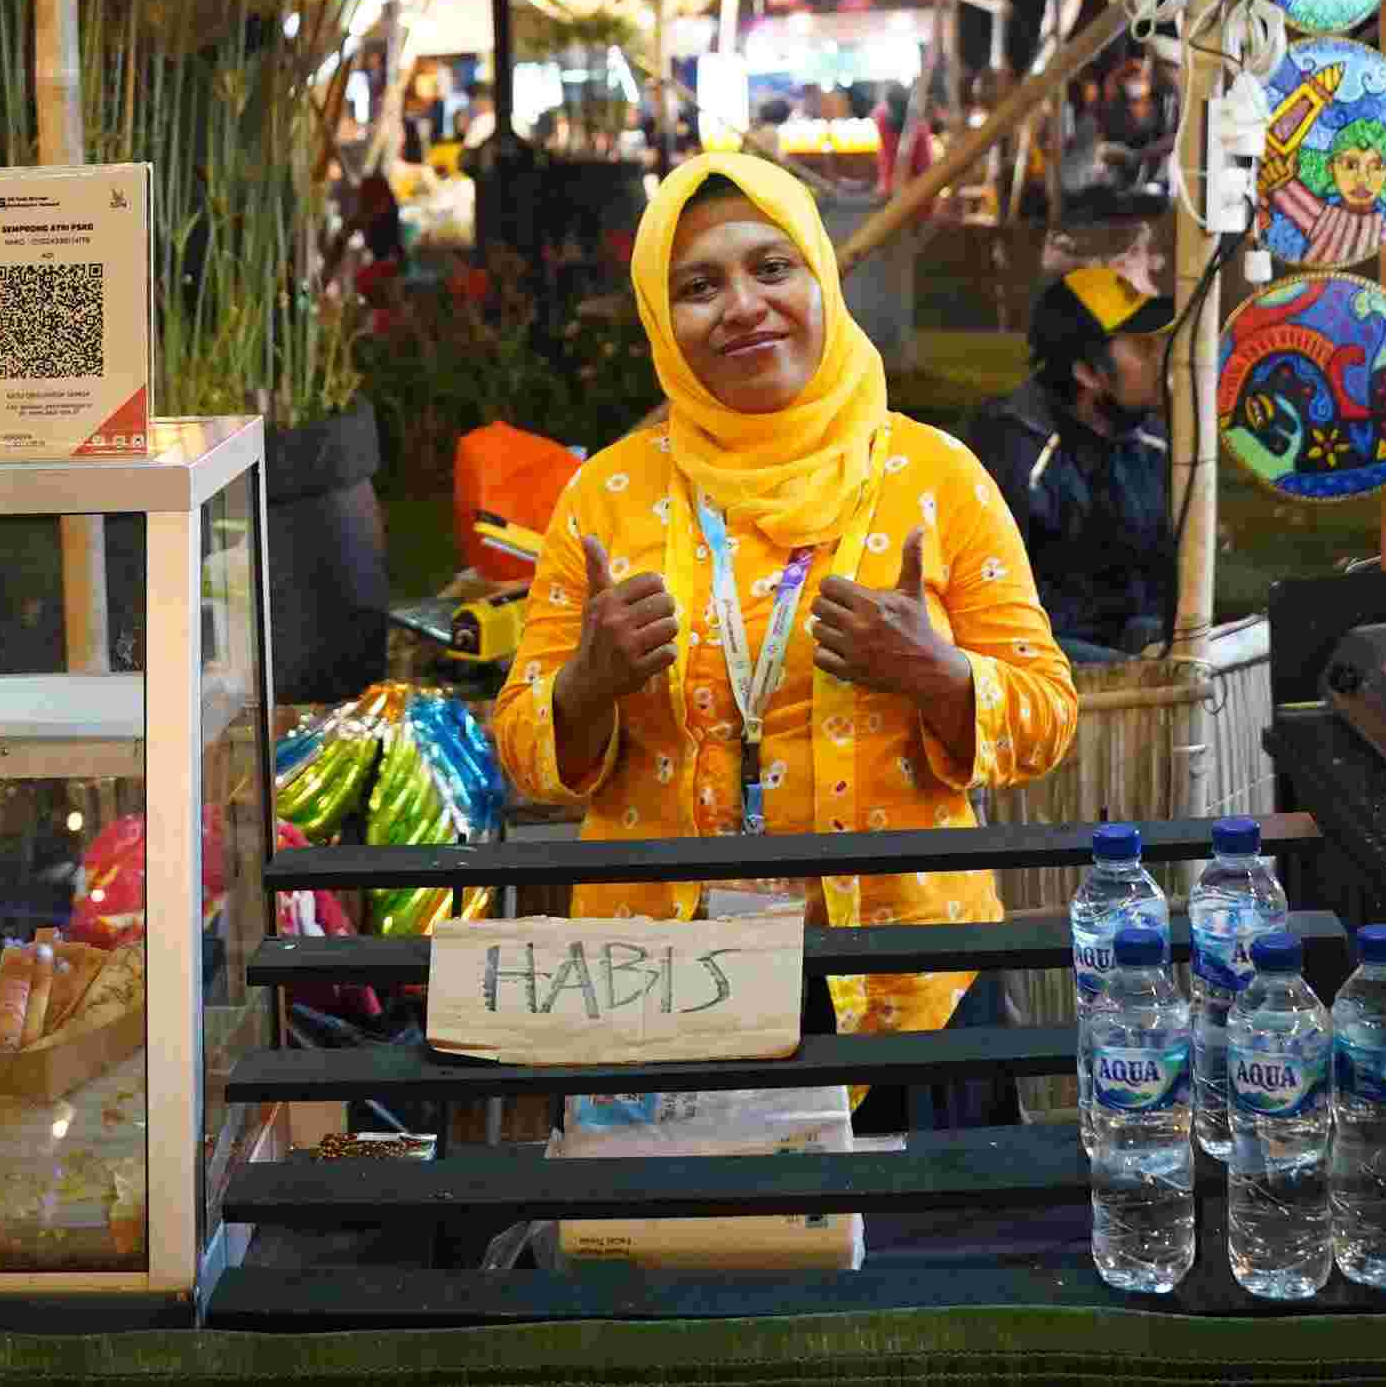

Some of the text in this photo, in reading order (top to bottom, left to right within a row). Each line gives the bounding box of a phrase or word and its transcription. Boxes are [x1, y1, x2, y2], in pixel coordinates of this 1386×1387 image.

[483, 940, 742, 1020] HABIS
[1099, 1057, 1160, 1087] AQUA
[1237, 1060, 1297, 1092] AQUA
